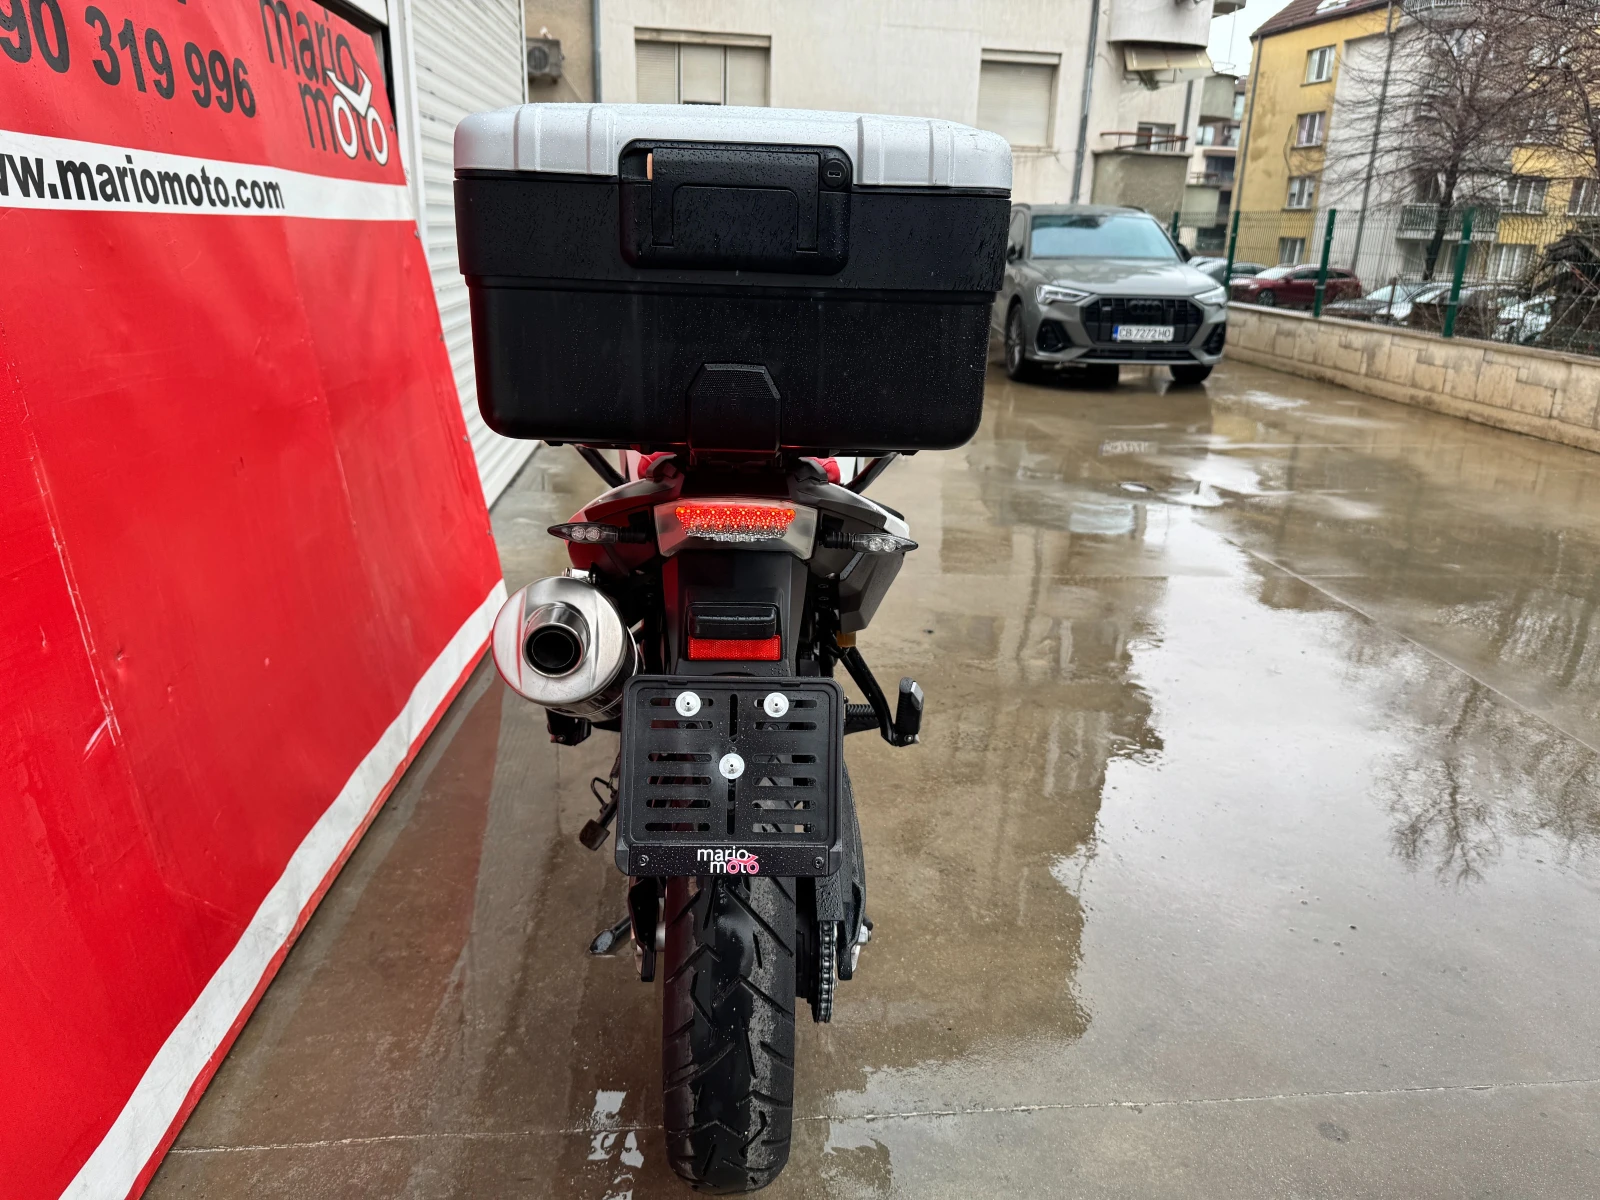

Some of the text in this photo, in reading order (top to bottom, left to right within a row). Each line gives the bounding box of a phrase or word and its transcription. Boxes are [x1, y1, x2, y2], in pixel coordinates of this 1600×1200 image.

[85, 6, 175, 99] 319
[184, 42, 256, 118] 996
[259, 0, 360, 91] mario
[298, 82, 389, 166] moto
[0, 153, 285, 210] w.mariomoto.com
[697, 846, 748, 861] mario
[710, 861, 759, 874] moto
